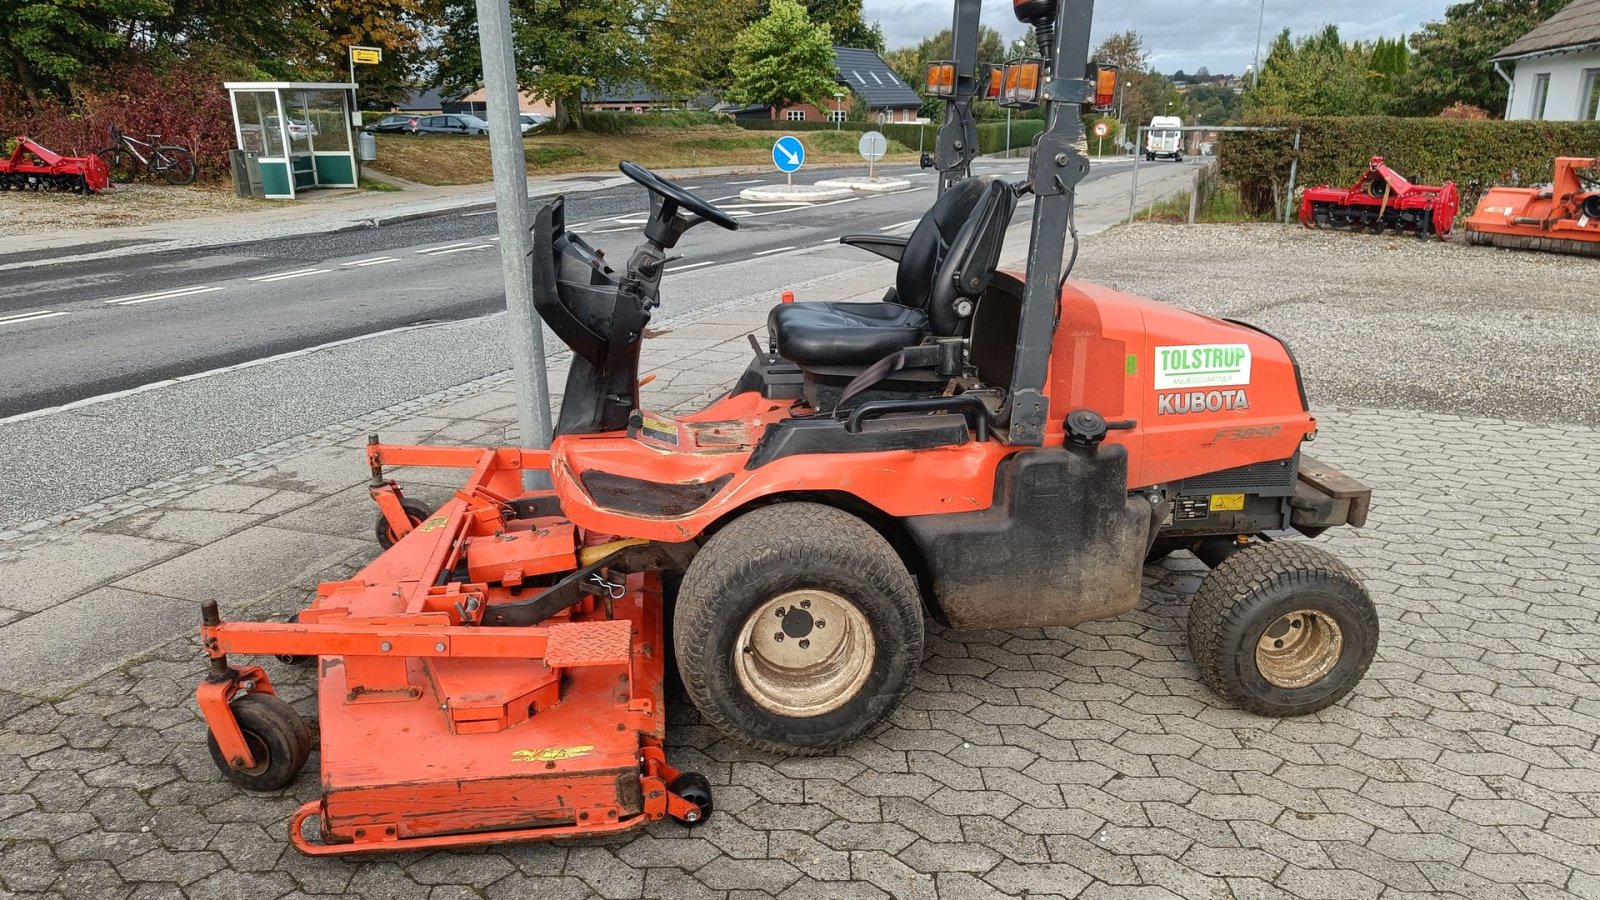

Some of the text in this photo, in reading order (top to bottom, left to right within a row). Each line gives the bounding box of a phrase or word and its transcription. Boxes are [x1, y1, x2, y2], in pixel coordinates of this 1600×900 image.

[1126, 353, 1137, 376] 8
[1161, 347, 1246, 371] TOLSTRUP
[1157, 389, 1250, 416] KUBOTA
[1212, 423, 1282, 443] F3890
